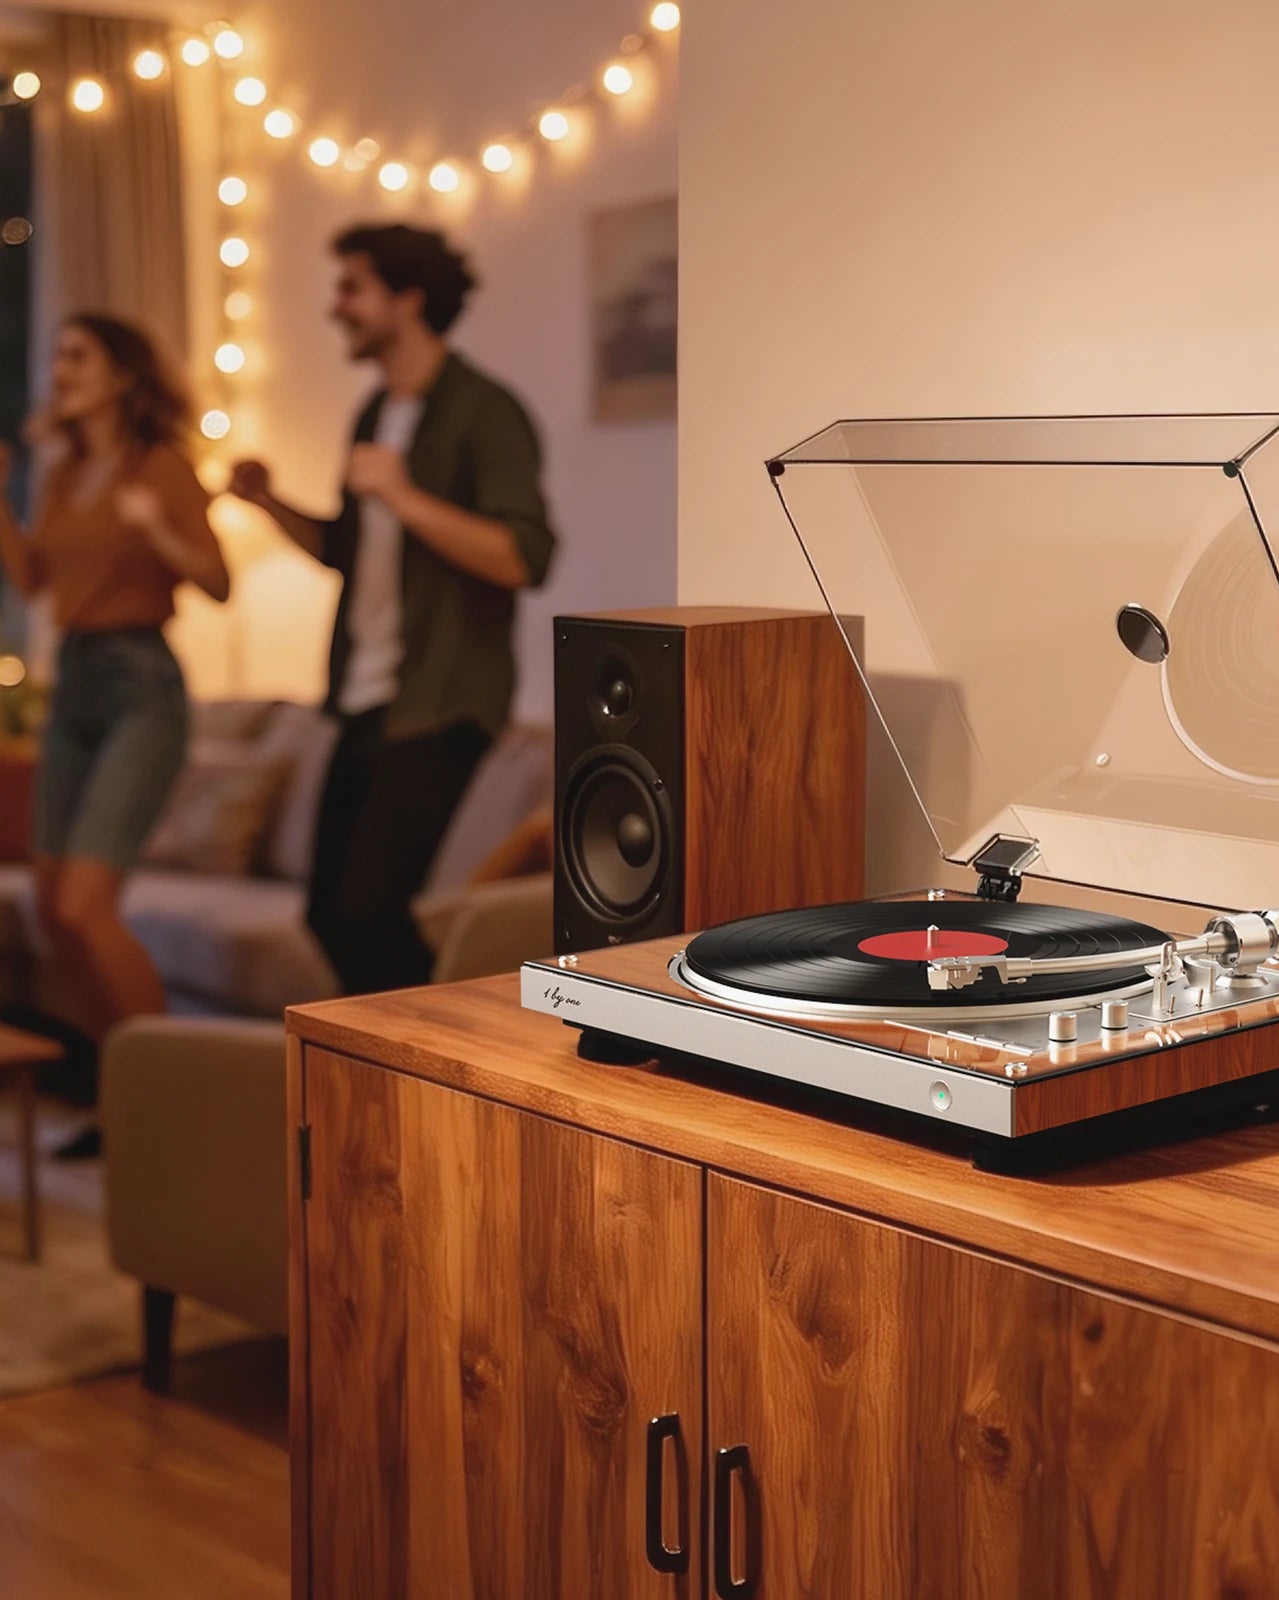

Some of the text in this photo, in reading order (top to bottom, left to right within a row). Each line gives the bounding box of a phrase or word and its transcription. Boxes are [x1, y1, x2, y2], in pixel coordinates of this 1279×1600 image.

[543, 987, 581, 1008] 1 by one
